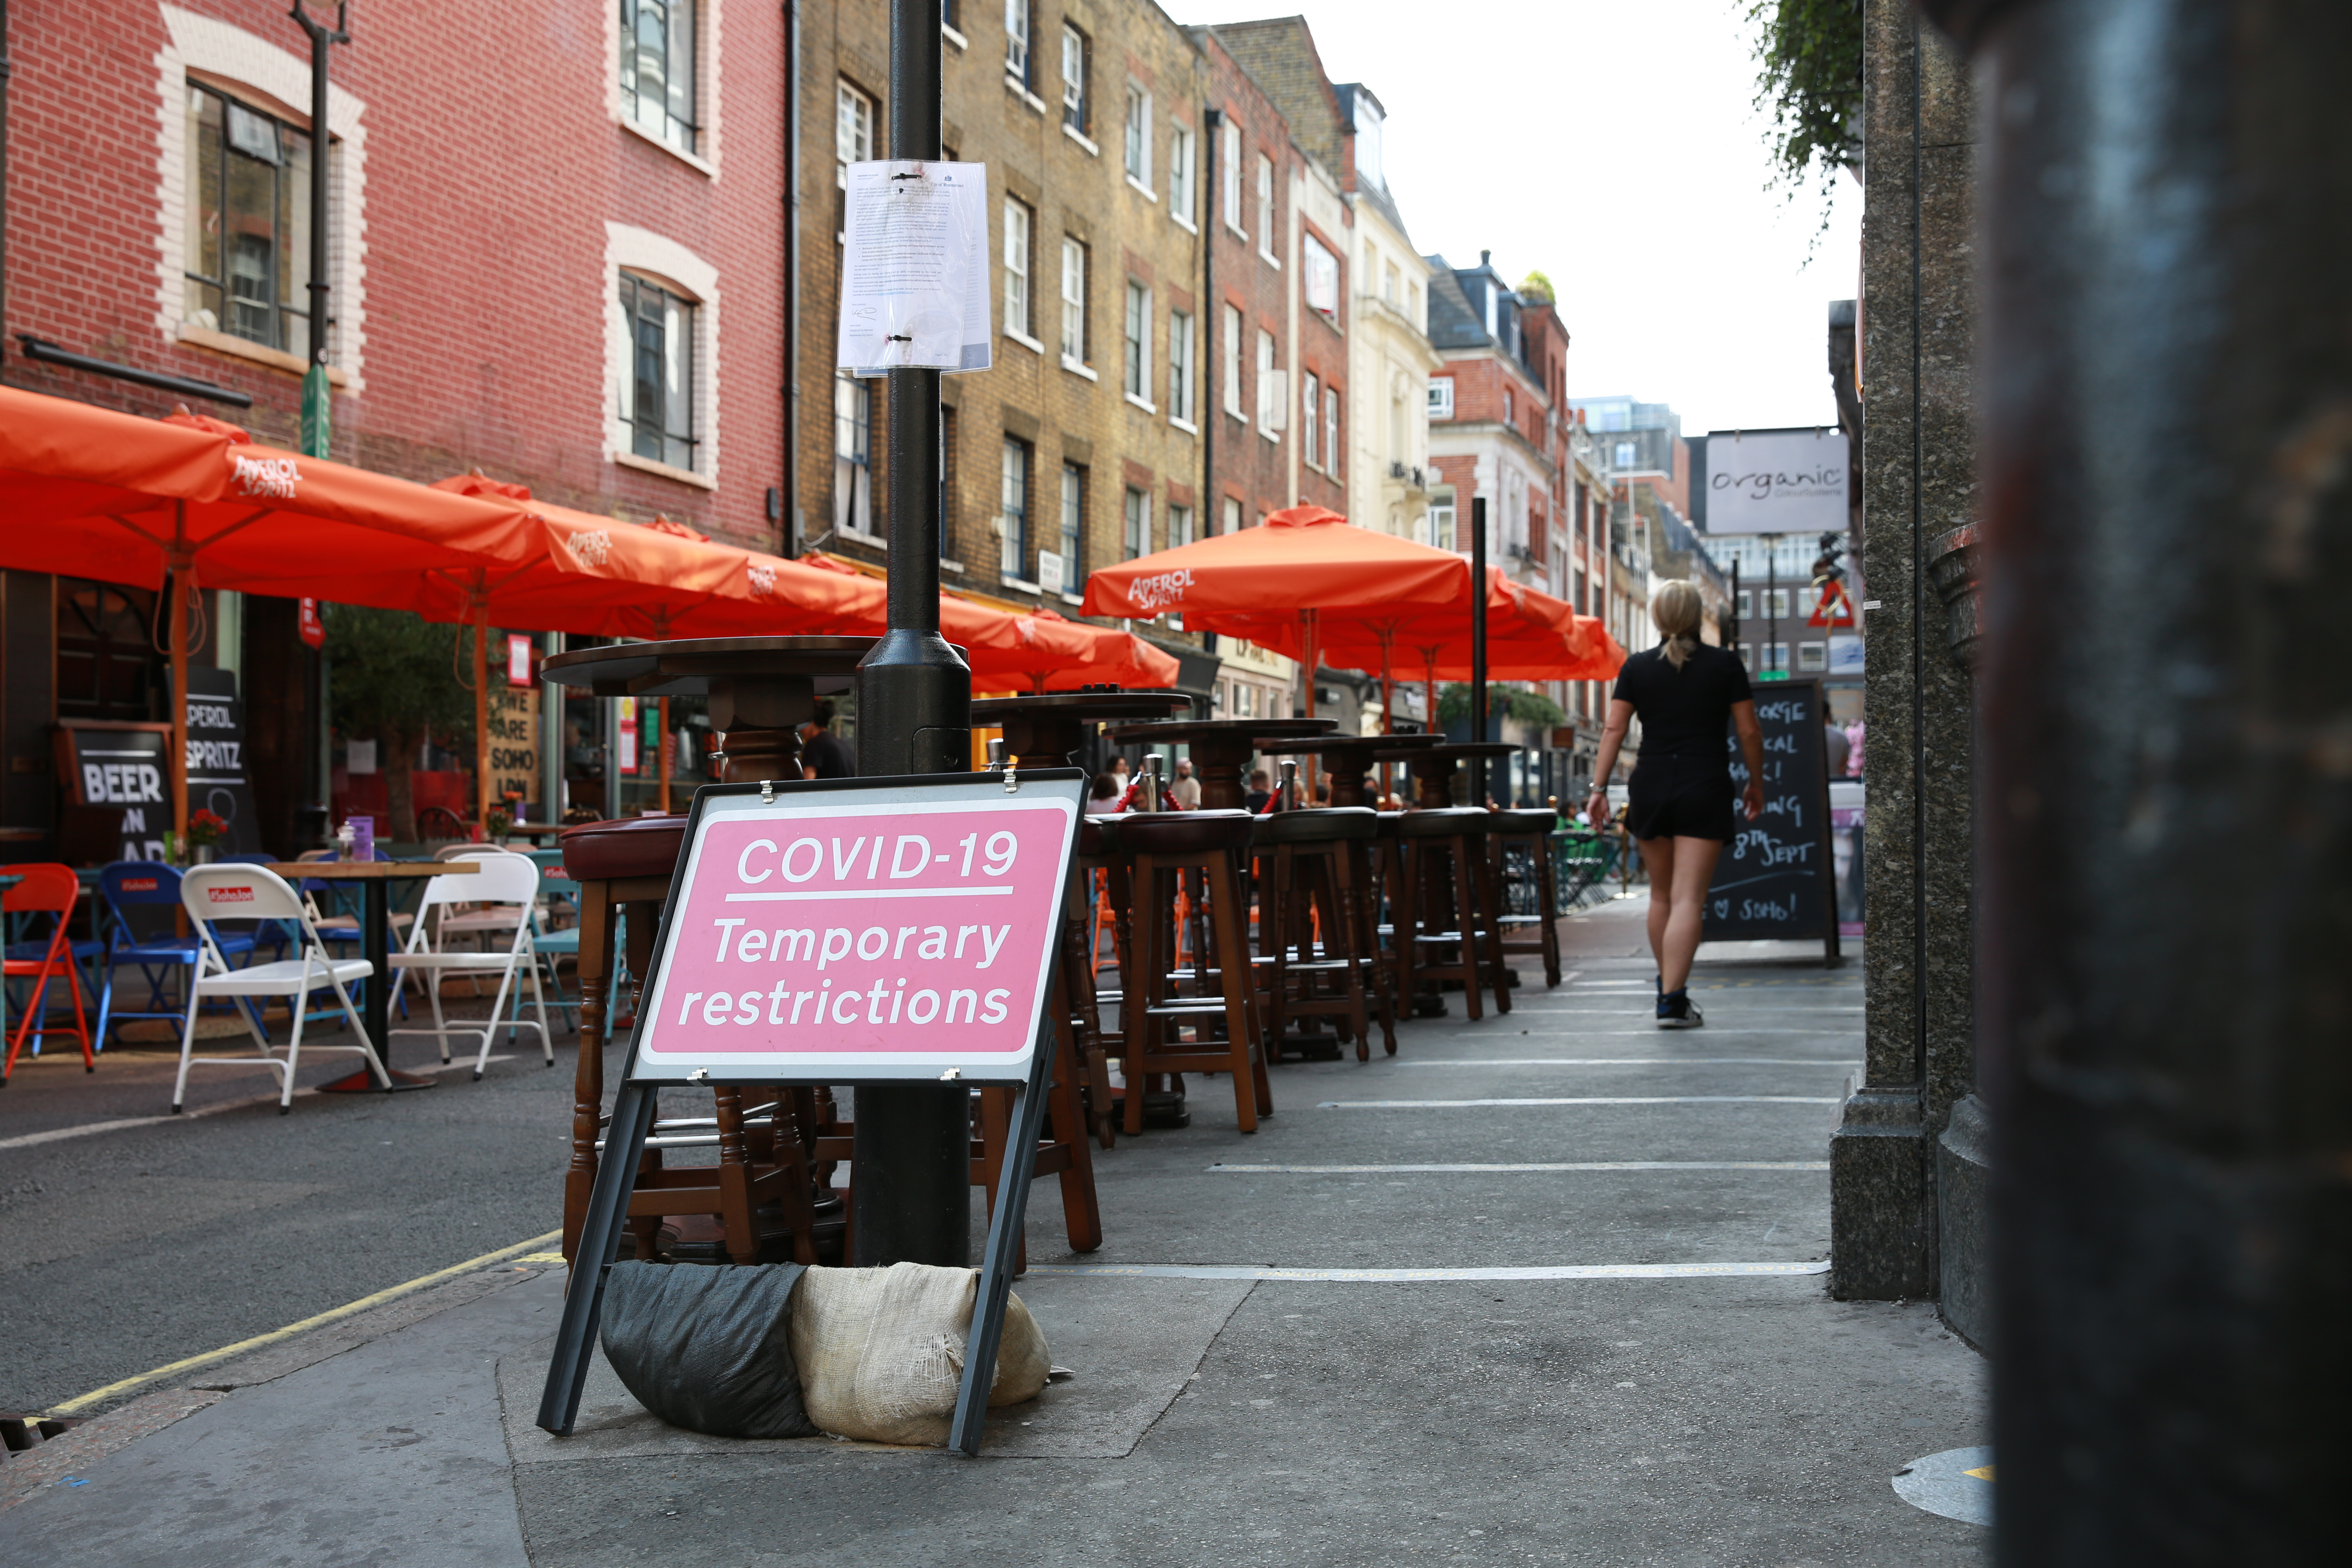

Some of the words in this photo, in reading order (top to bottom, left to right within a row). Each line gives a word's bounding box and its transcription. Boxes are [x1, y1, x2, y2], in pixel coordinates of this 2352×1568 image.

[1712, 464, 1843, 500] organic
[1127, 568, 1196, 601] APEROL
[185, 704, 236, 729] PEROL
[492, 748, 533, 771] SOHO
[82, 762, 164, 803] BEER
[737, 830, 1018, 884] COVID-19
[1760, 837, 1817, 867] SEPT
[713, 918, 1011, 970] Temporary
[677, 978, 1011, 1026] restrictions
